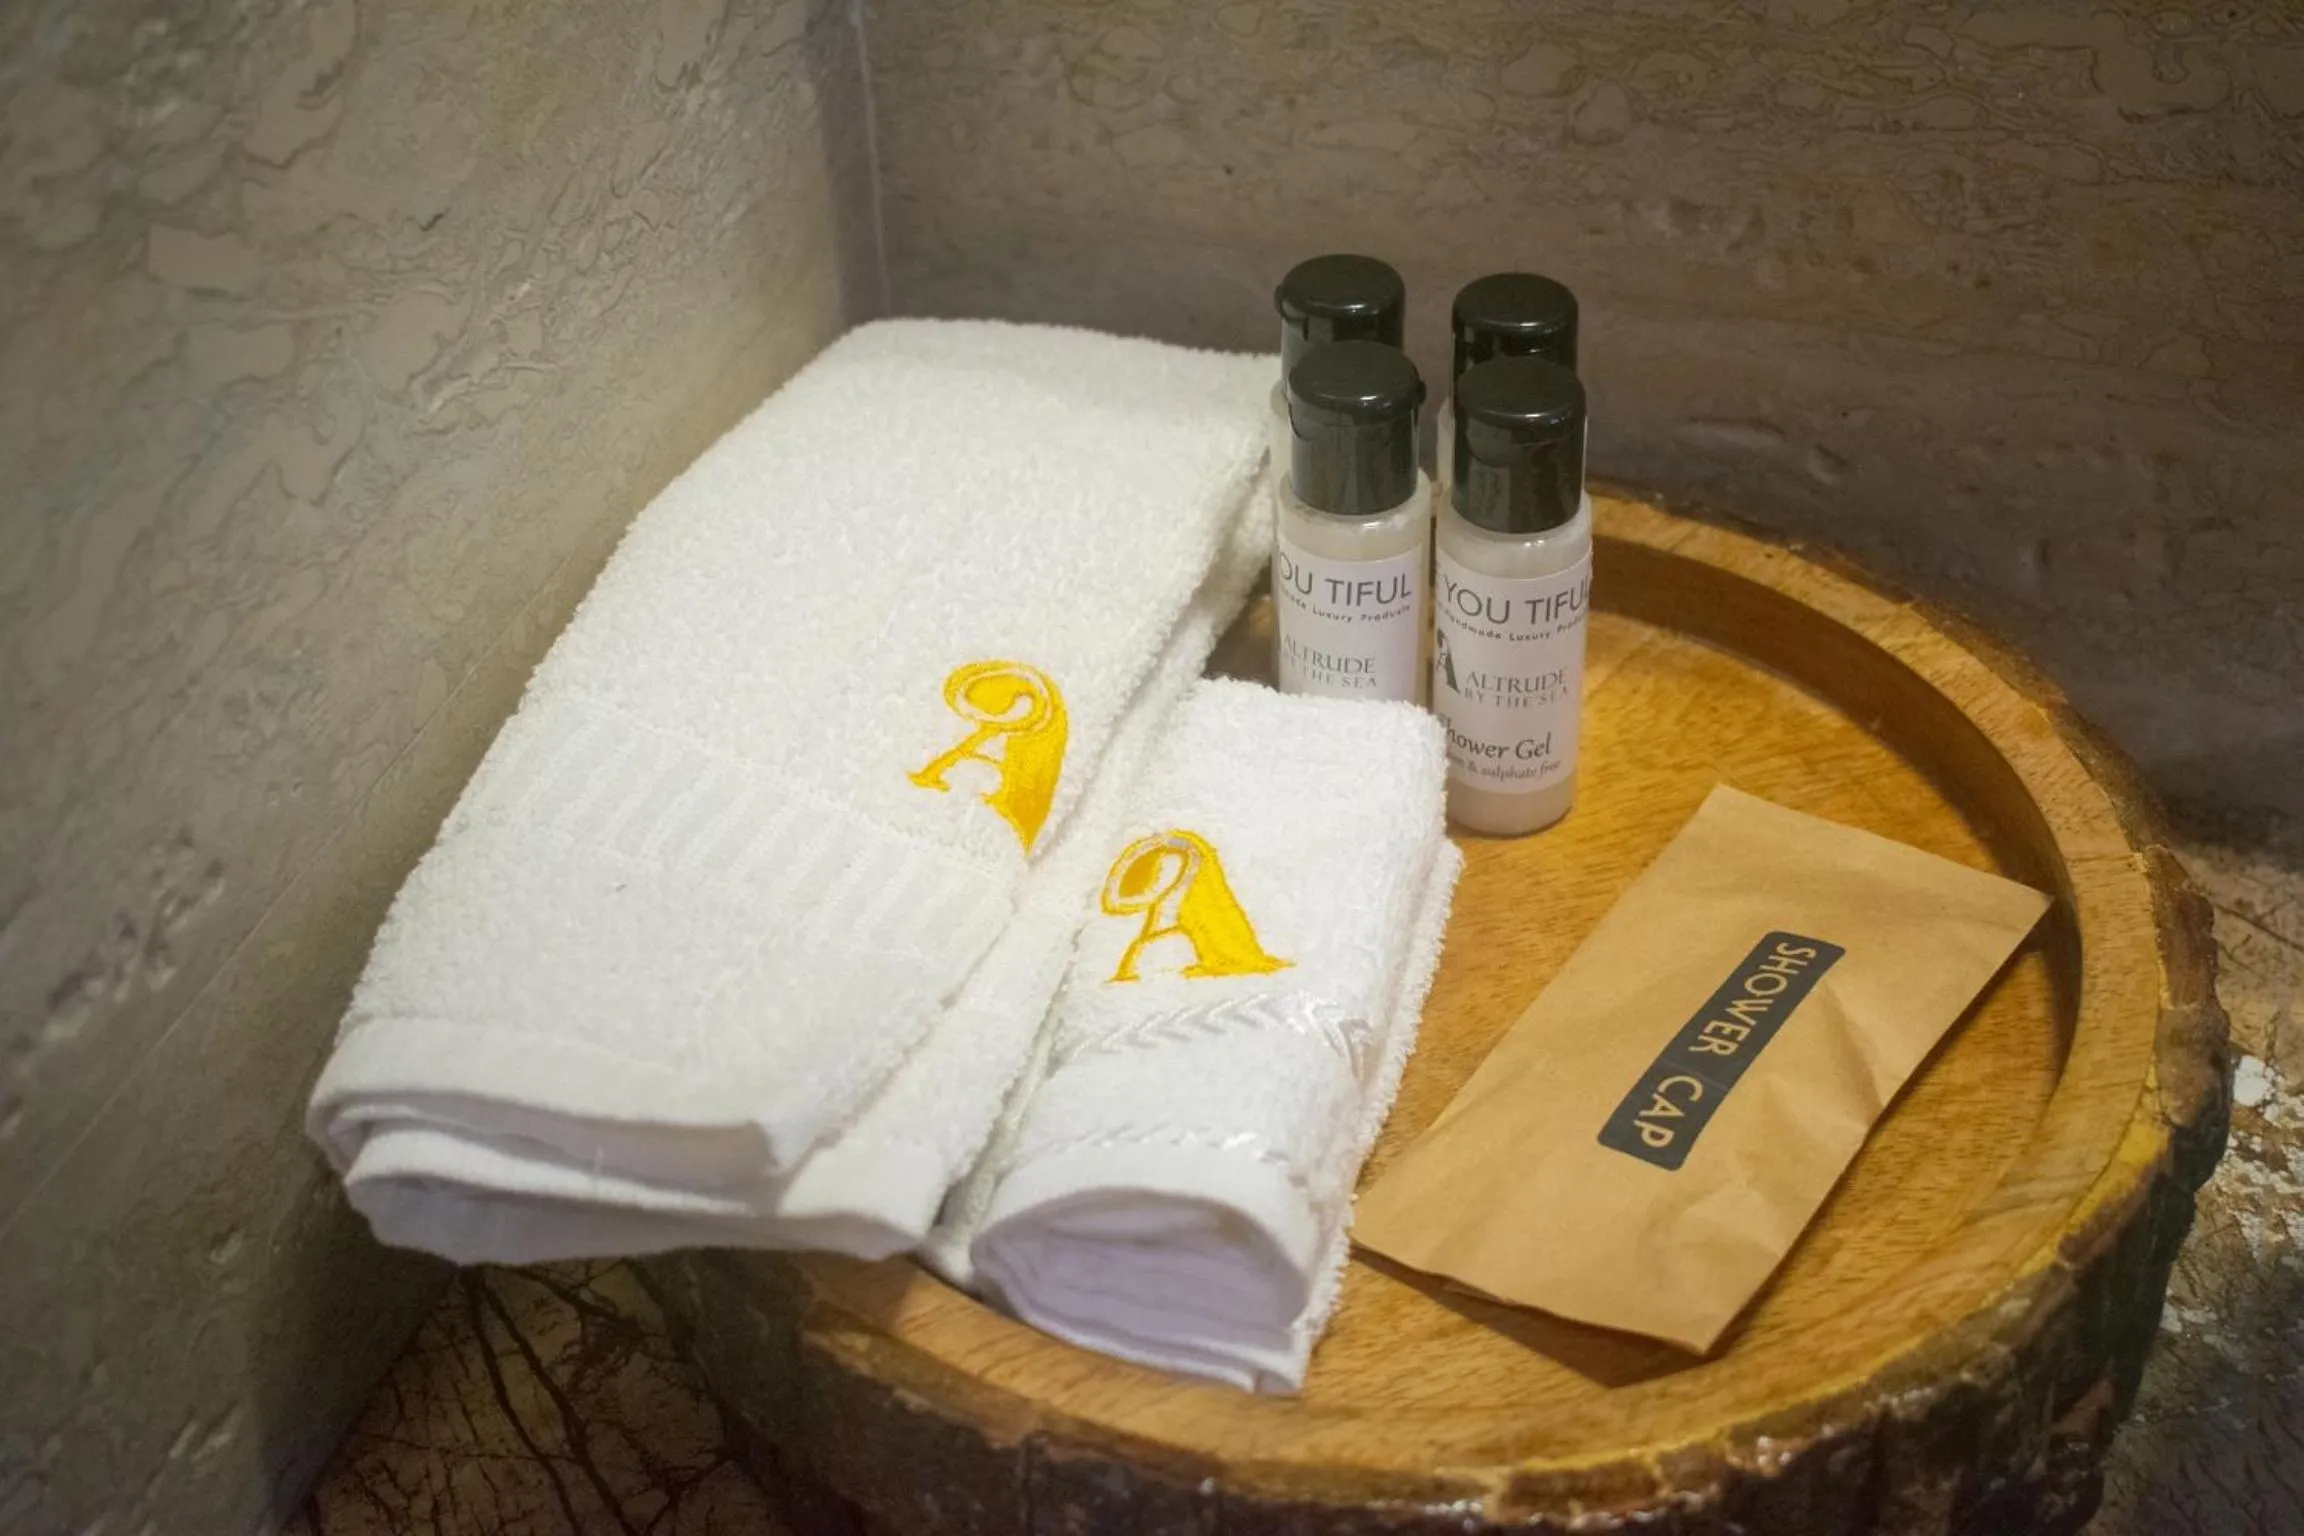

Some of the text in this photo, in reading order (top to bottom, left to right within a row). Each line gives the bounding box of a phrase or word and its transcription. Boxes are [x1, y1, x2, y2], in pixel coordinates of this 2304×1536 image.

[1324, 572, 1412, 606] TIFUL
[1444, 573, 1511, 625] YOU
[1312, 605, 1353, 623] Luxury
[1508, 631, 1551, 643] Luxury
[1284, 634, 1377, 674] ALTRUDE
[1341, 676, 1377, 689] SEA
[1466, 666, 1568, 695] ALTRUDE
[1492, 693, 1530, 709] THE
[1515, 730, 1552, 761] Gel
[1481, 764, 1537, 781] sulphate
[1633, 942, 1817, 1148] SHOWER CAP
